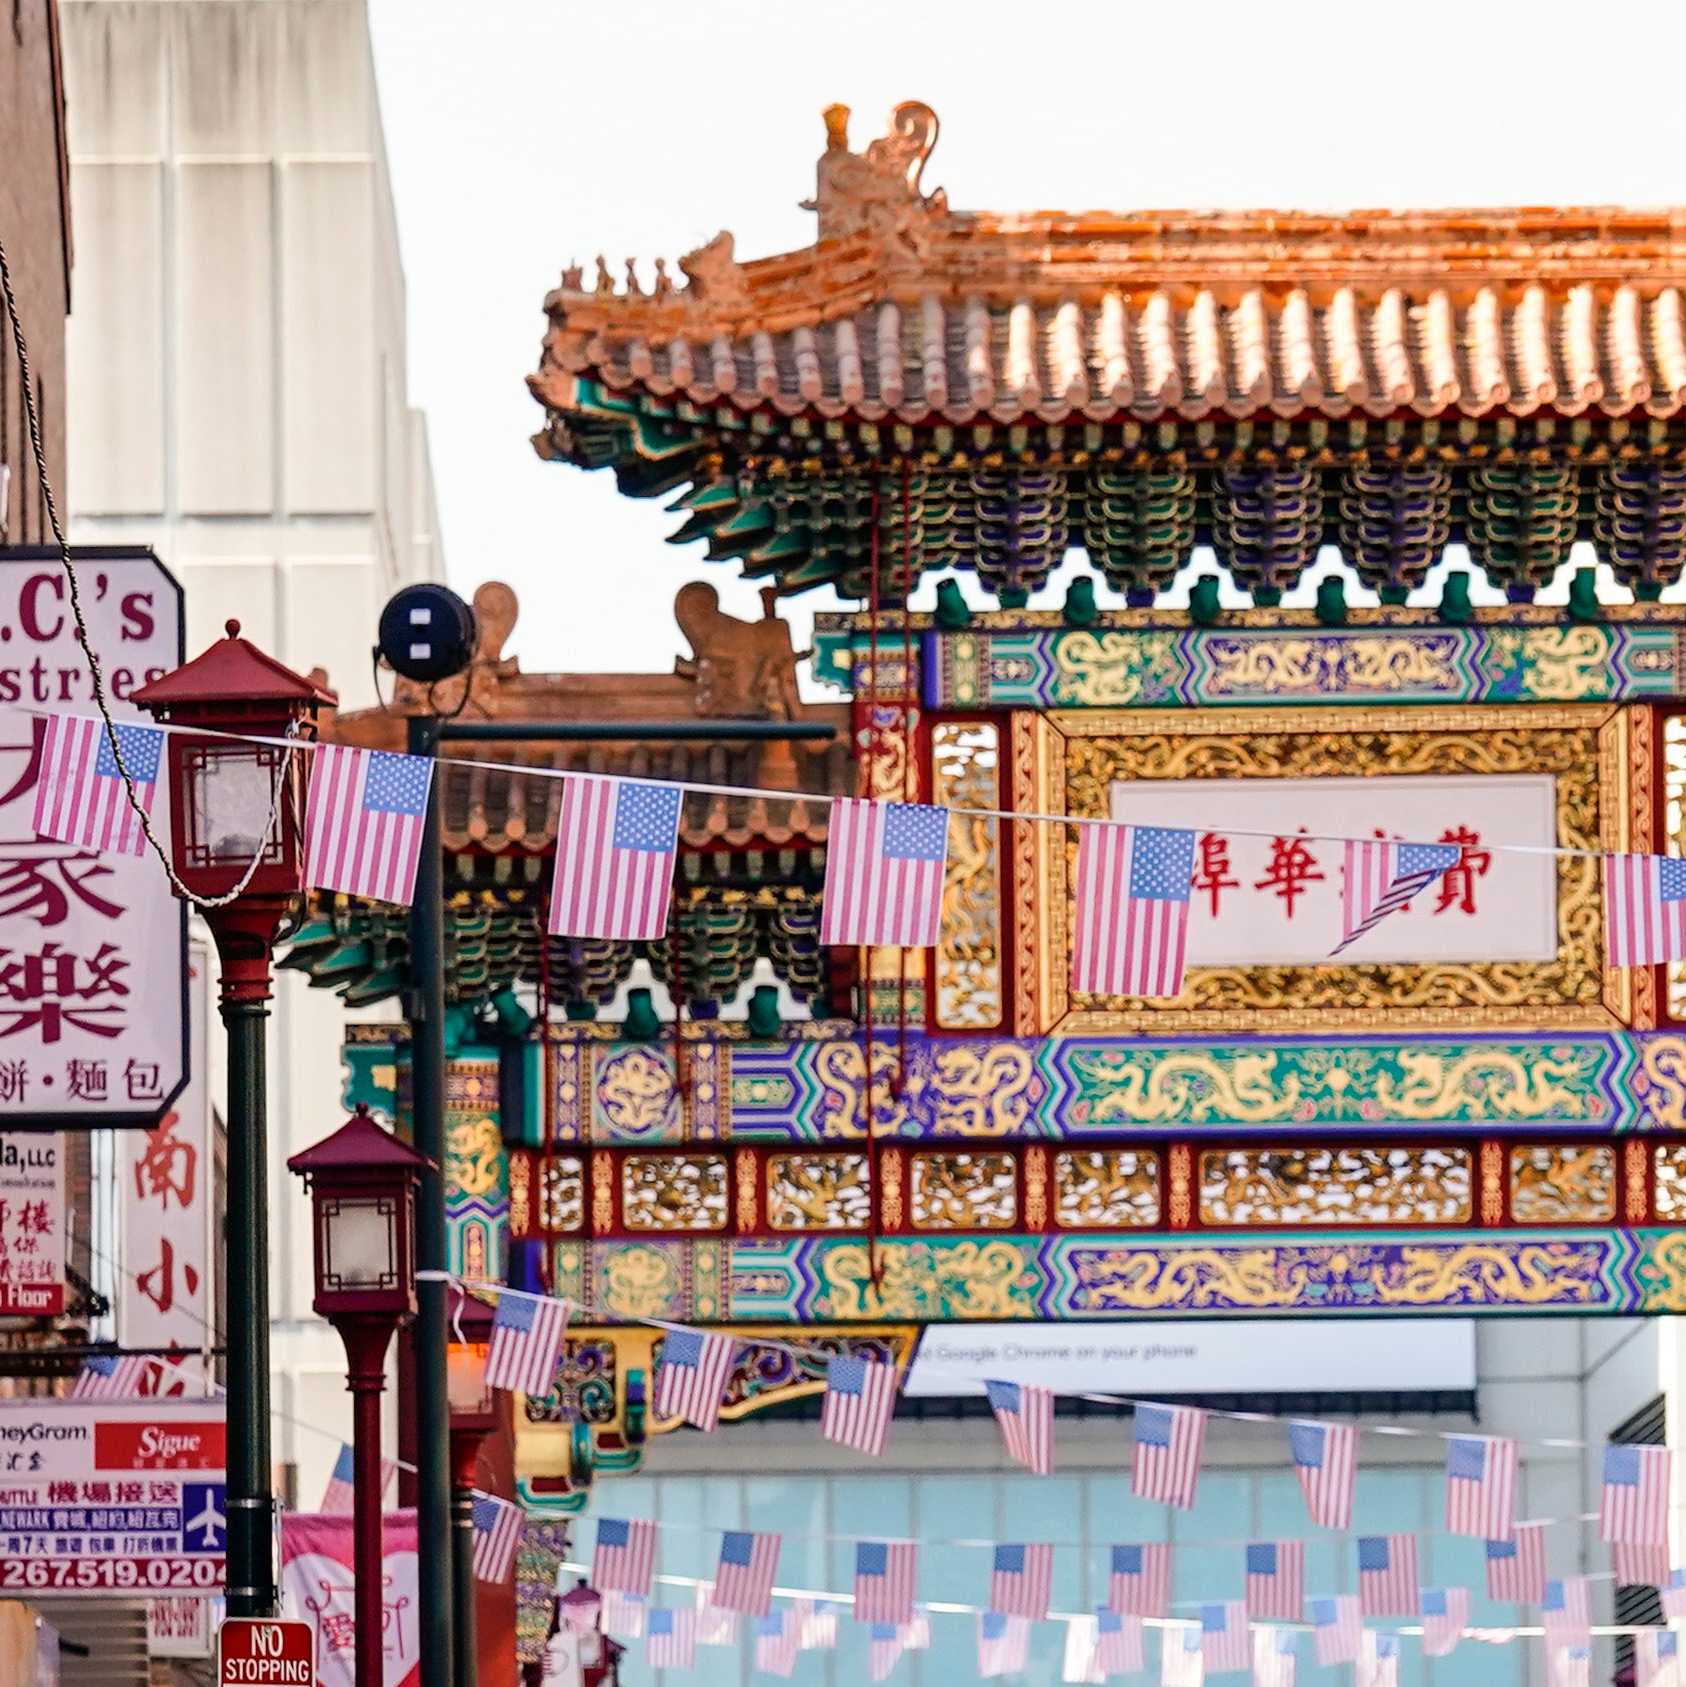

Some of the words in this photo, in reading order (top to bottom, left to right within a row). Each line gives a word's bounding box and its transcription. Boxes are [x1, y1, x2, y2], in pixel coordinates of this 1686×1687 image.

[8, 1284, 53, 1307] Floor
[251, 1624, 284, 1657] NO
[225, 1658, 310, 1682] STOPPING
